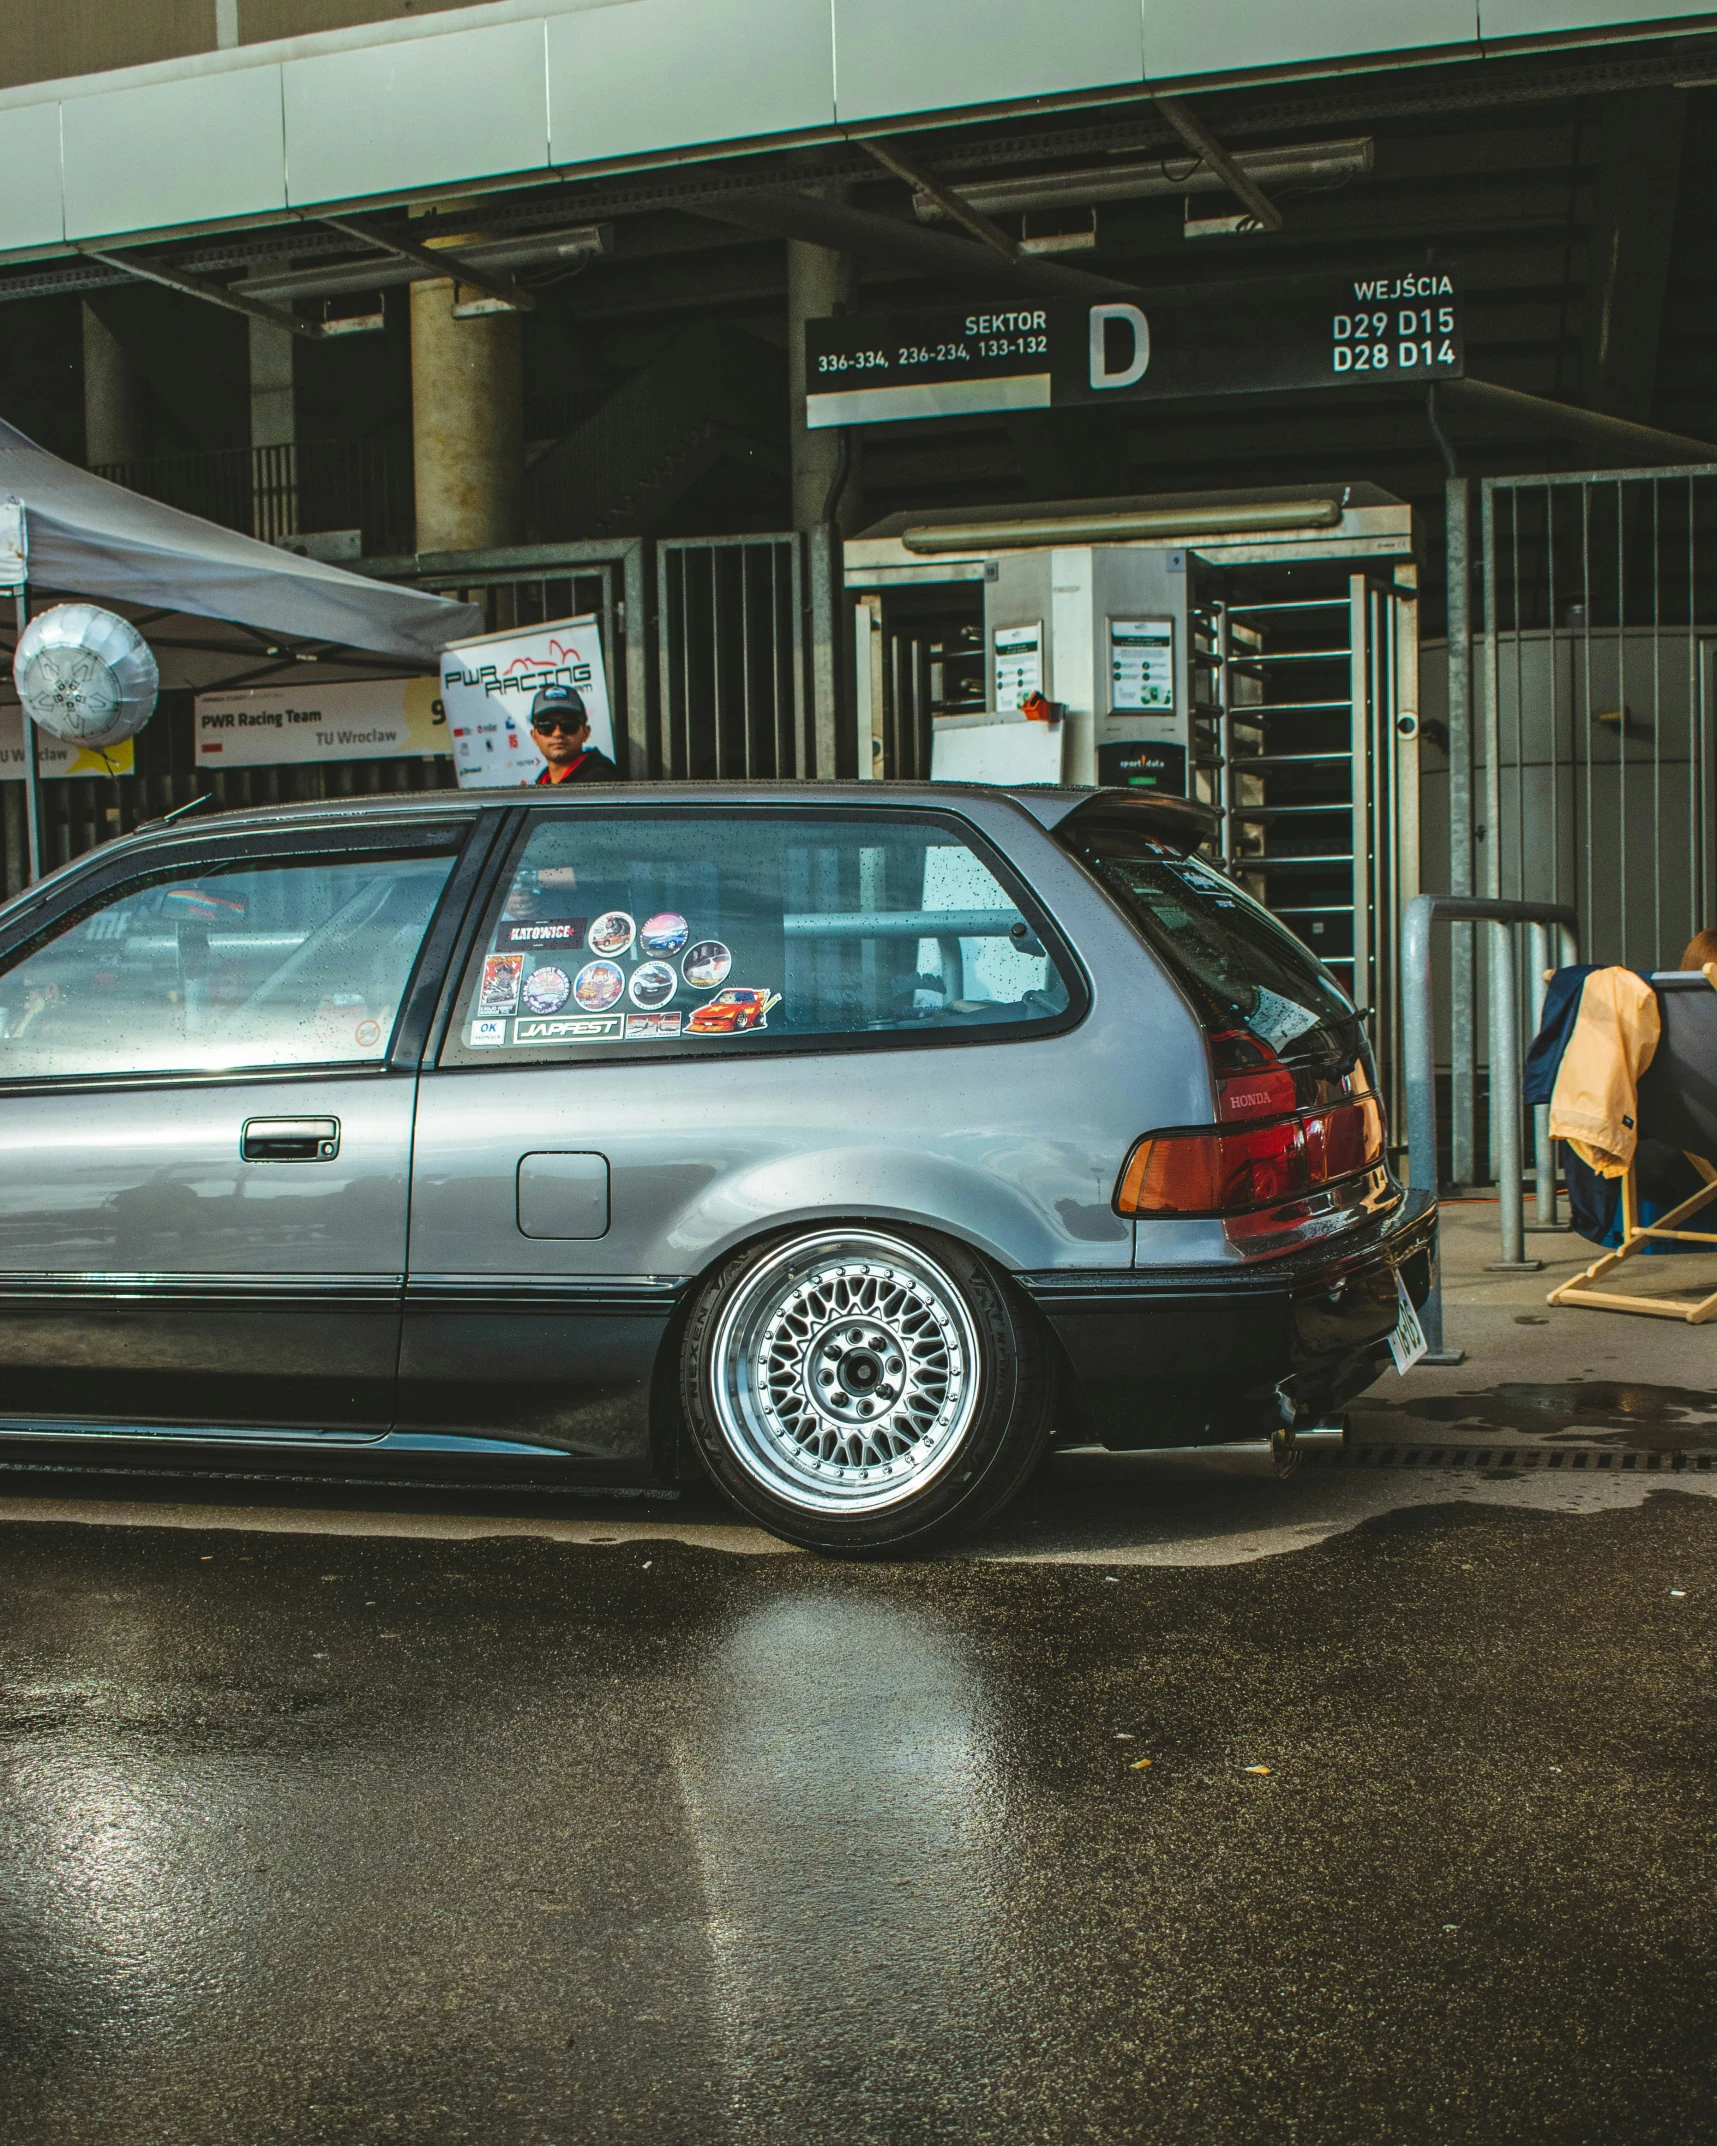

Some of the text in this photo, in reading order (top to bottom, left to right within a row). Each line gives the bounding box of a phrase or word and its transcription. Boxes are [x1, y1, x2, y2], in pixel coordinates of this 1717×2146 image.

[1354, 273, 1453, 301] WEJŚCIA
[965, 311, 1047, 335] SEKTOR
[1333, 307, 1454, 340] D29 D15
[818, 336, 1047, 372] 336-334, 236-234, 133-132
[1090, 303, 1150, 389] D
[1333, 339, 1456, 372] D28 D14
[444, 665, 498, 689] PWR
[484, 663, 591, 697] RACING
[201, 709, 322, 728] PWR Racing Team
[316, 728, 397, 746] TU Wroclaw
[511, 925, 571, 940] KATOWICE
[480, 1023, 498, 1033] OK
[521, 1021, 617, 1037] JAPFEST
[1230, 1092, 1271, 1108] HONDA
[690, 1307, 708, 1398] NEXEN
